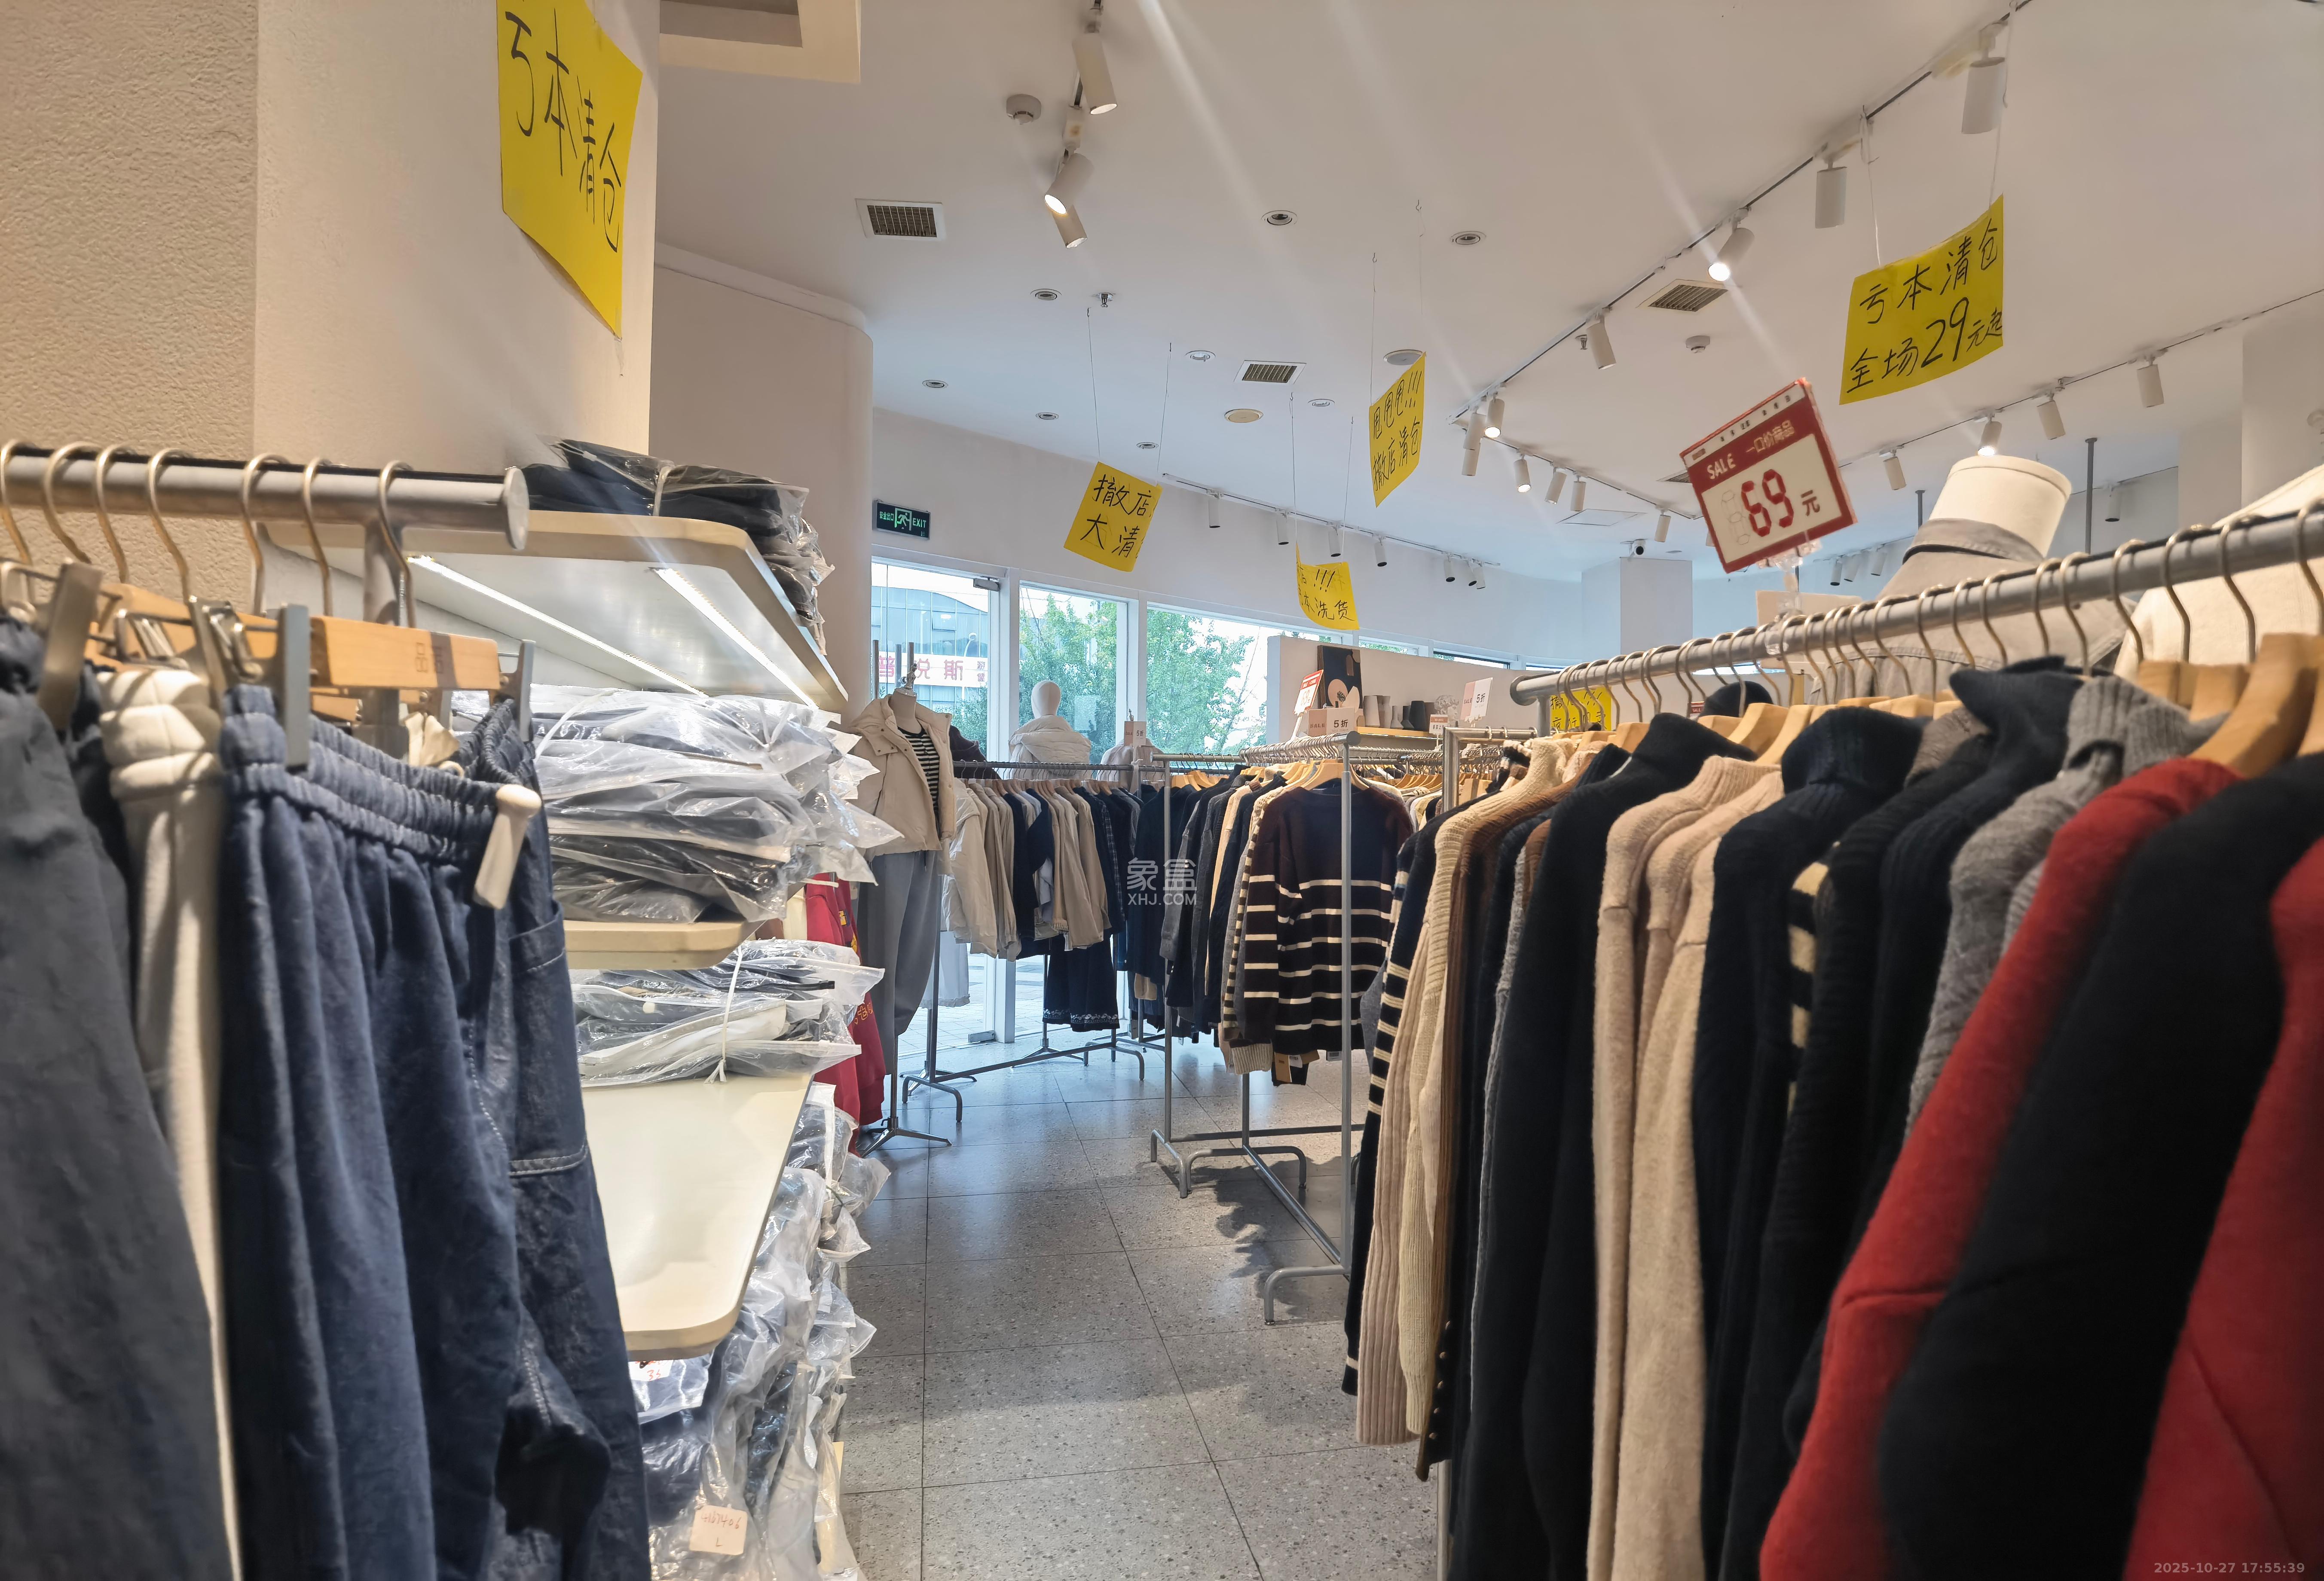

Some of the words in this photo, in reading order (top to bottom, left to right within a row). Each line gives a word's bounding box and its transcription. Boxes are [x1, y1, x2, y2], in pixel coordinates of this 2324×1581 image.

[1860, 218, 1998, 324] 亏本清仓
[1846, 297, 2003, 394] 全场29元起
[1706, 453, 1737, 480] SALE
[1092, 474, 1152, 516] 撤店
[879, 511, 894, 522] 安全出口
[912, 517, 927, 528] EXIT
[1333, 719, 1348, 728] 5折
